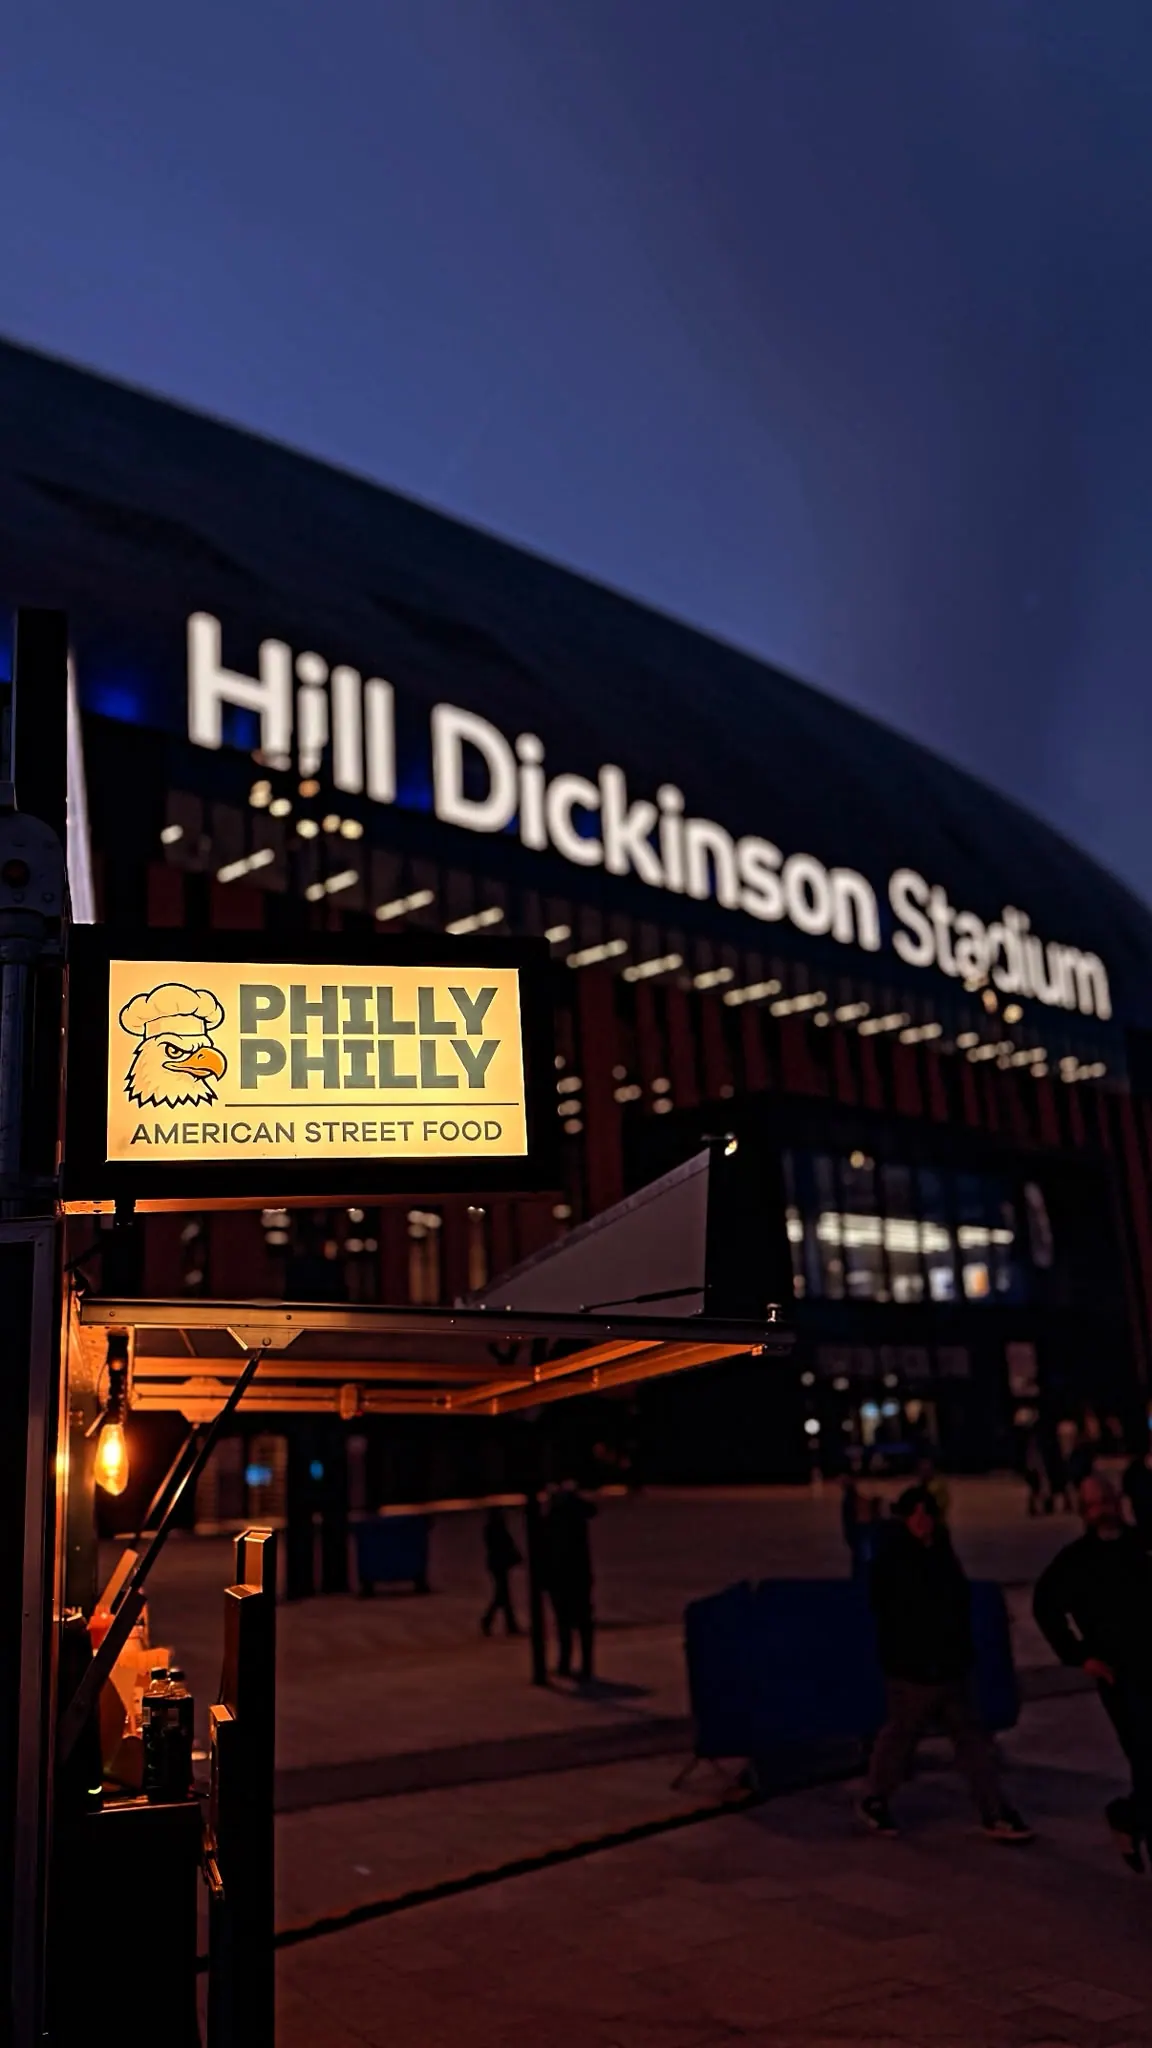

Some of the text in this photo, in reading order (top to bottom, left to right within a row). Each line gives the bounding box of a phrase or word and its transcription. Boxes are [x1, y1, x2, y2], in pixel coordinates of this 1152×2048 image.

[187, 611, 1112, 1021] Hill Dickinson Stadium
[239, 984, 499, 1036] PHILLY
[239, 1038, 501, 1090] PHILLY
[130, 1120, 502, 1144] AMERICAN STREET FOOD
